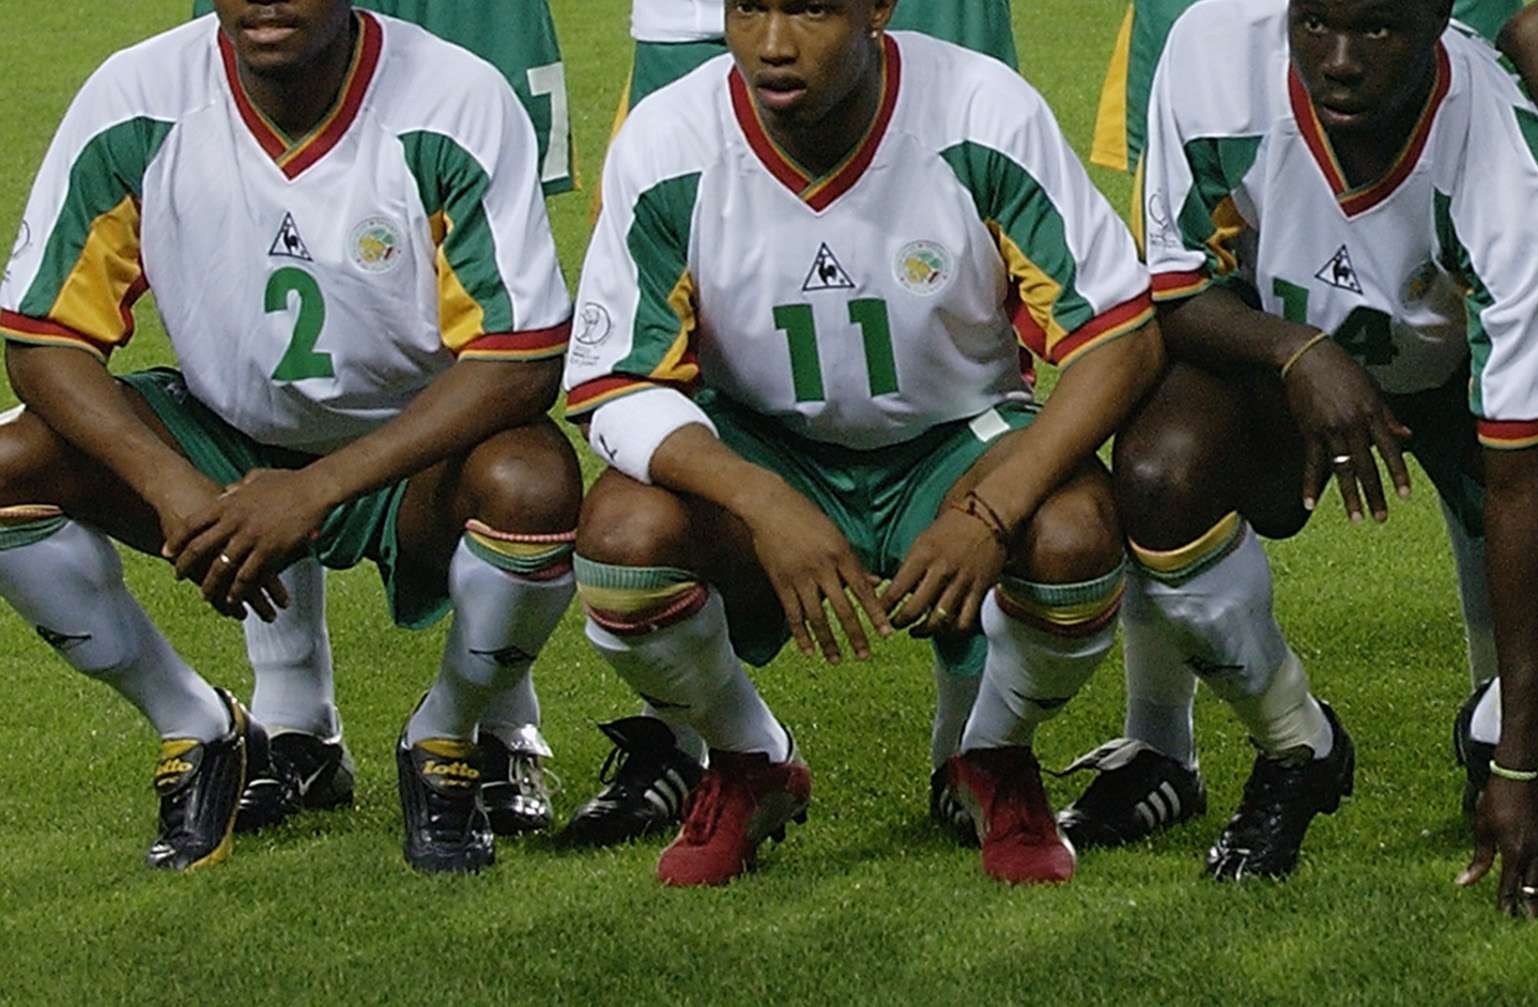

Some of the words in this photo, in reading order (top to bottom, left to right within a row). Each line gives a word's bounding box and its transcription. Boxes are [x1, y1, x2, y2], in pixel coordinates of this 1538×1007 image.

[263, 266, 335, 382] 2
[773, 298, 901, 403] 11
[1272, 277, 1399, 366] 14
